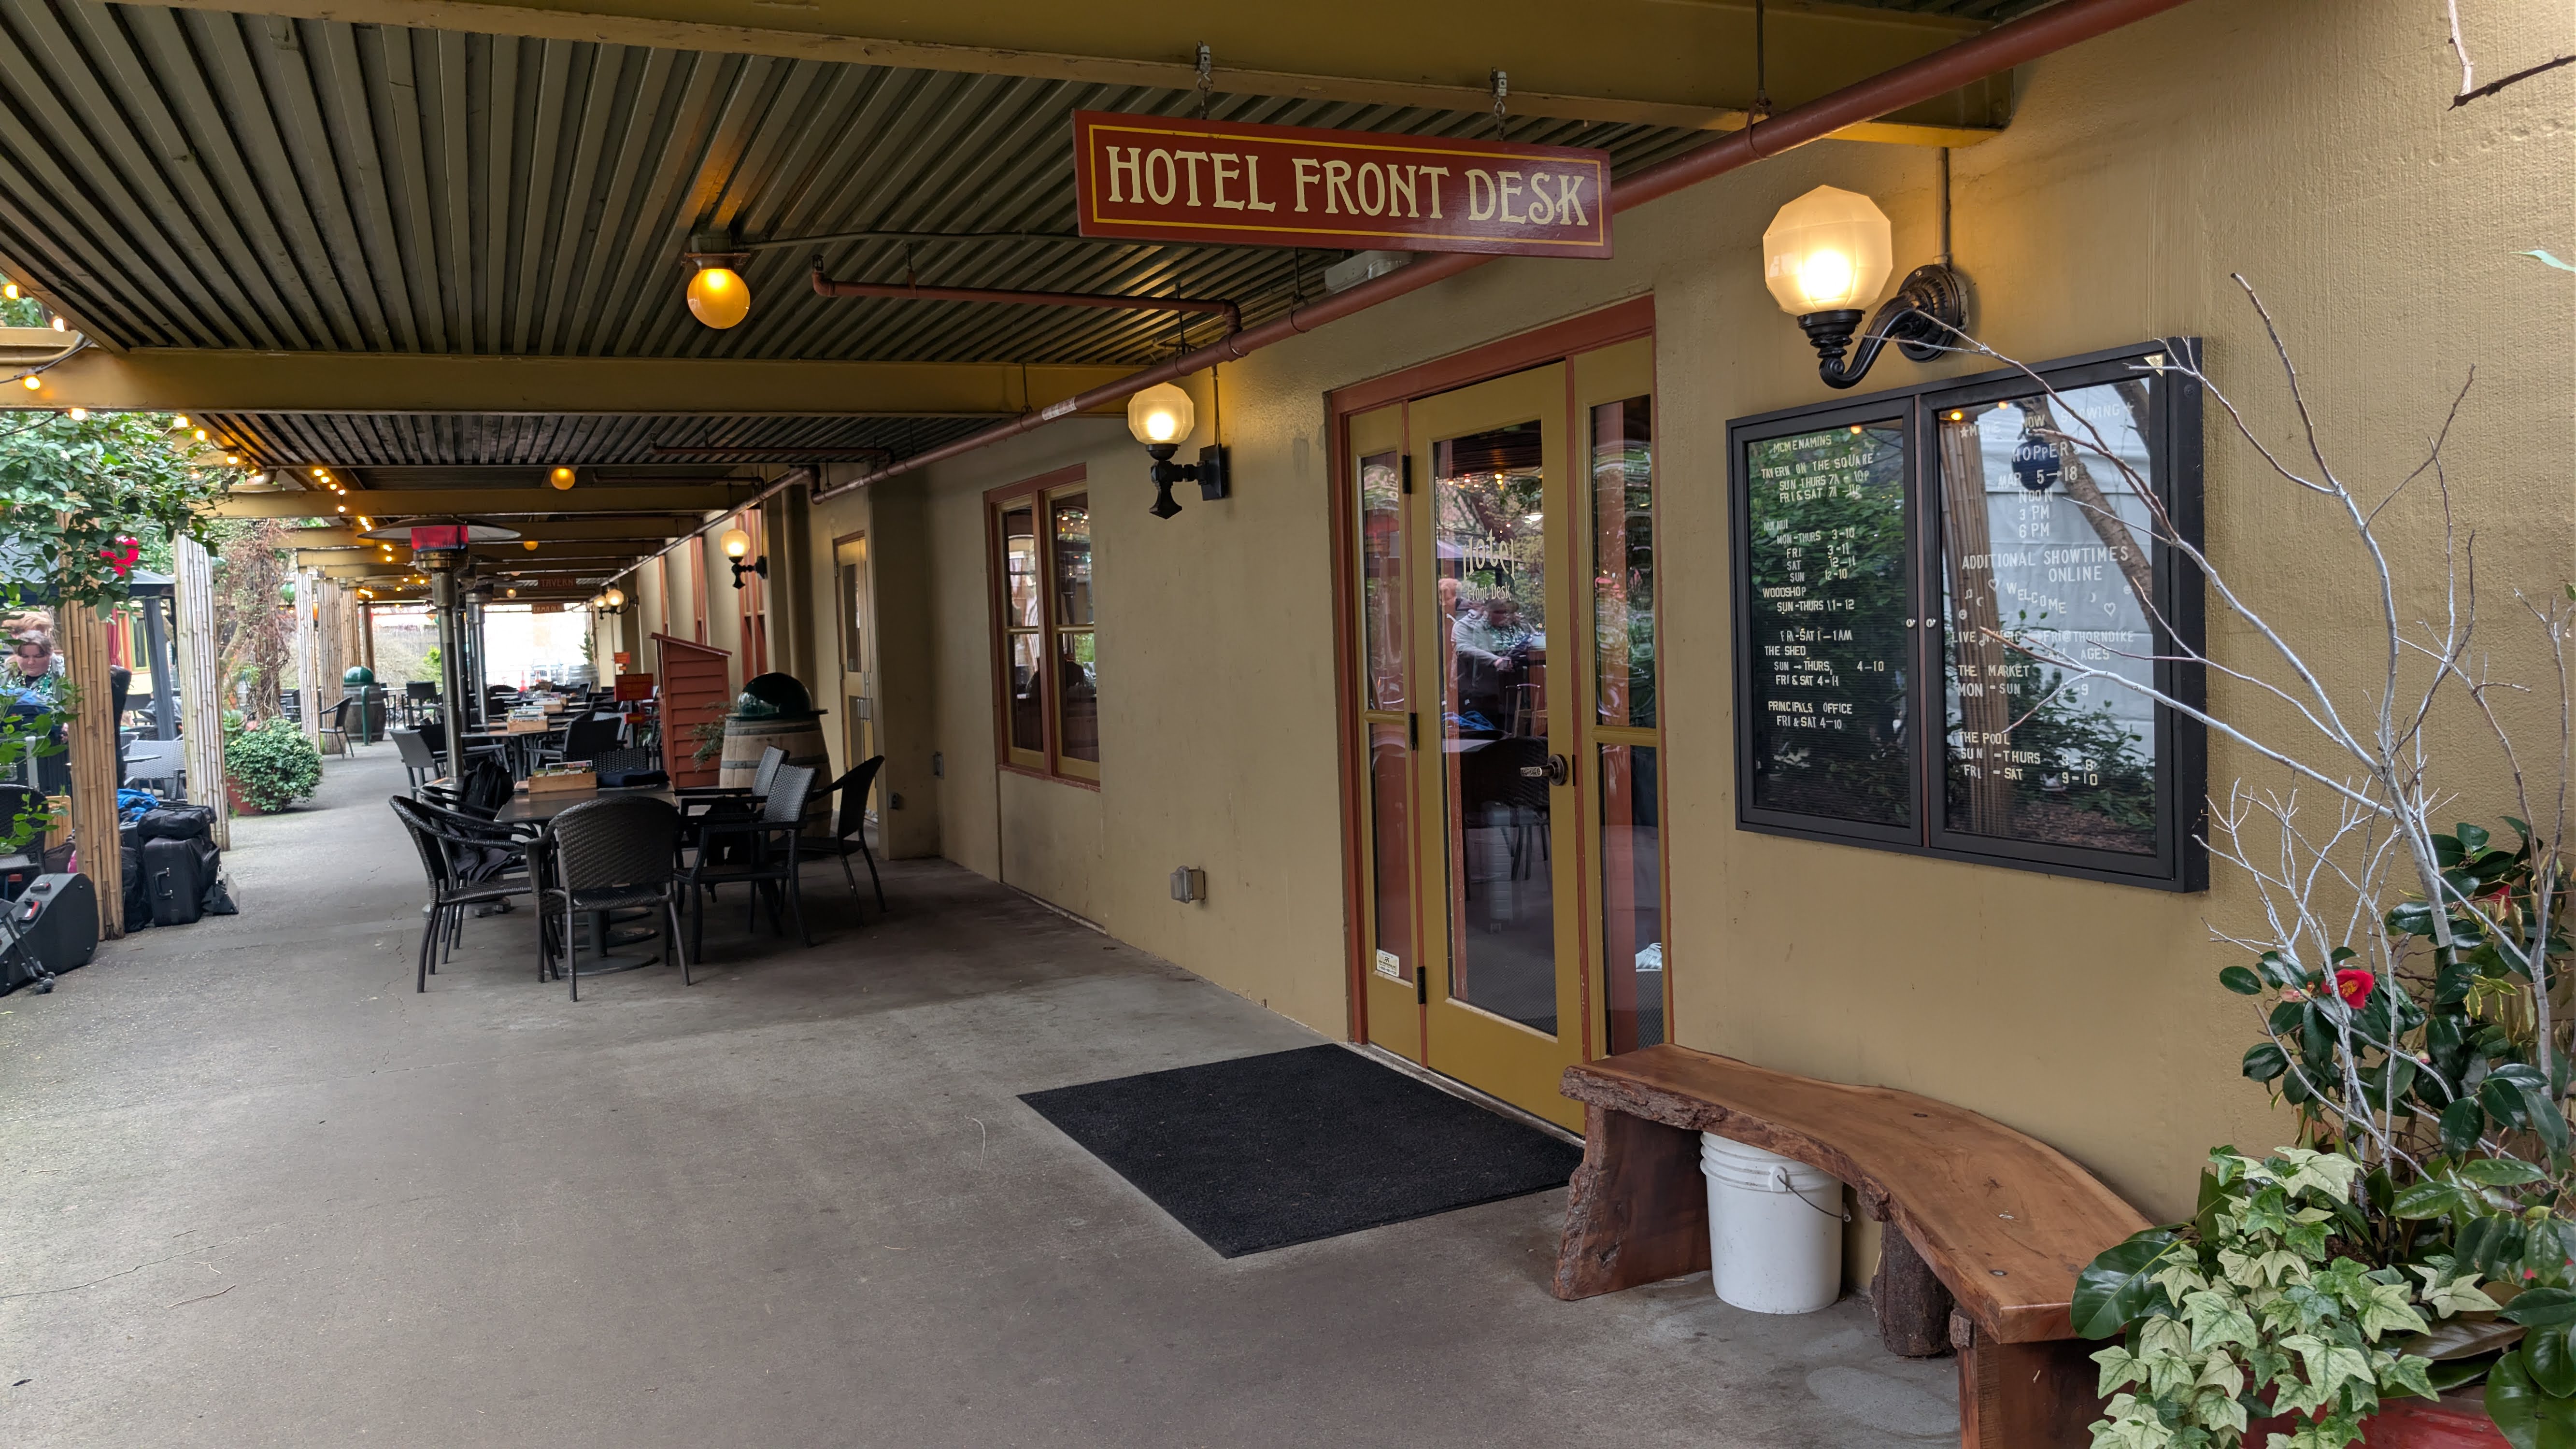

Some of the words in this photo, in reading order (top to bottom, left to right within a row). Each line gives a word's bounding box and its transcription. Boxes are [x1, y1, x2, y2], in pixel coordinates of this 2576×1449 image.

[1106, 146, 1276, 212] HOTEL
[1292, 158, 1450, 219] FRONT
[1465, 169, 1589, 226] DESK
[1773, 435, 1832, 453] MCMENAMINS
[1761, 466, 1790, 479] TAVERN
[1795, 462, 1807, 474] ON
[1813, 460, 1830, 471] THE
[1834, 453, 1873, 469] SQUARE
[1998, 472, 2022, 489] MAR
[2036, 469, 2045, 484] 5
[2064, 466, 2078, 482] 18
[2019, 488, 2053, 504] NOON
[2032, 504, 2049, 520] PM
[1764, 521, 1774, 531] NUI
[1777, 519, 1788, 530] NUI
[2031, 522, 2049, 538] PM
[1463, 528, 1516, 581] Hotel
[1786, 548, 1802, 558] FRI
[1962, 552, 2036, 570] ADDITIONAL
[2043, 546, 2129, 565] SHOWTIMES
[1787, 560, 1801, 571] SAT
[1790, 572, 1805, 582] SUN
[2049, 566, 2103, 582] ONLINE
[540, 578, 574, 587] TAVERN
[1467, 584, 1489, 603] Front
[1491, 582, 1511, 601] Desk
[1763, 586, 1807, 598] WOODSHOP
[2006, 582, 2067, 614] WELCOME
[1952, 631, 1976, 643] LIVE
[1765, 646, 1780, 656] THE
[1784, 646, 1806, 656] SHED
[2080, 648, 2110, 660] AGES
[1774, 661, 1789, 671] SUN
[1958, 665, 1978, 677] THE
[1988, 665, 2030, 677] MARKET
[1958, 682, 1983, 697] MON
[1999, 683, 2021, 695] SUN
[1768, 701, 1814, 713] PRINCIPALS
[1823, 702, 1853, 714] OFFICE
[1959, 731, 1978, 744] THE
[1982, 731, 2010, 745] POOL
[1961, 748, 1983, 760] SUN
[1964, 764, 1981, 779] FRI
[2005, 767, 2023, 781] SAT
